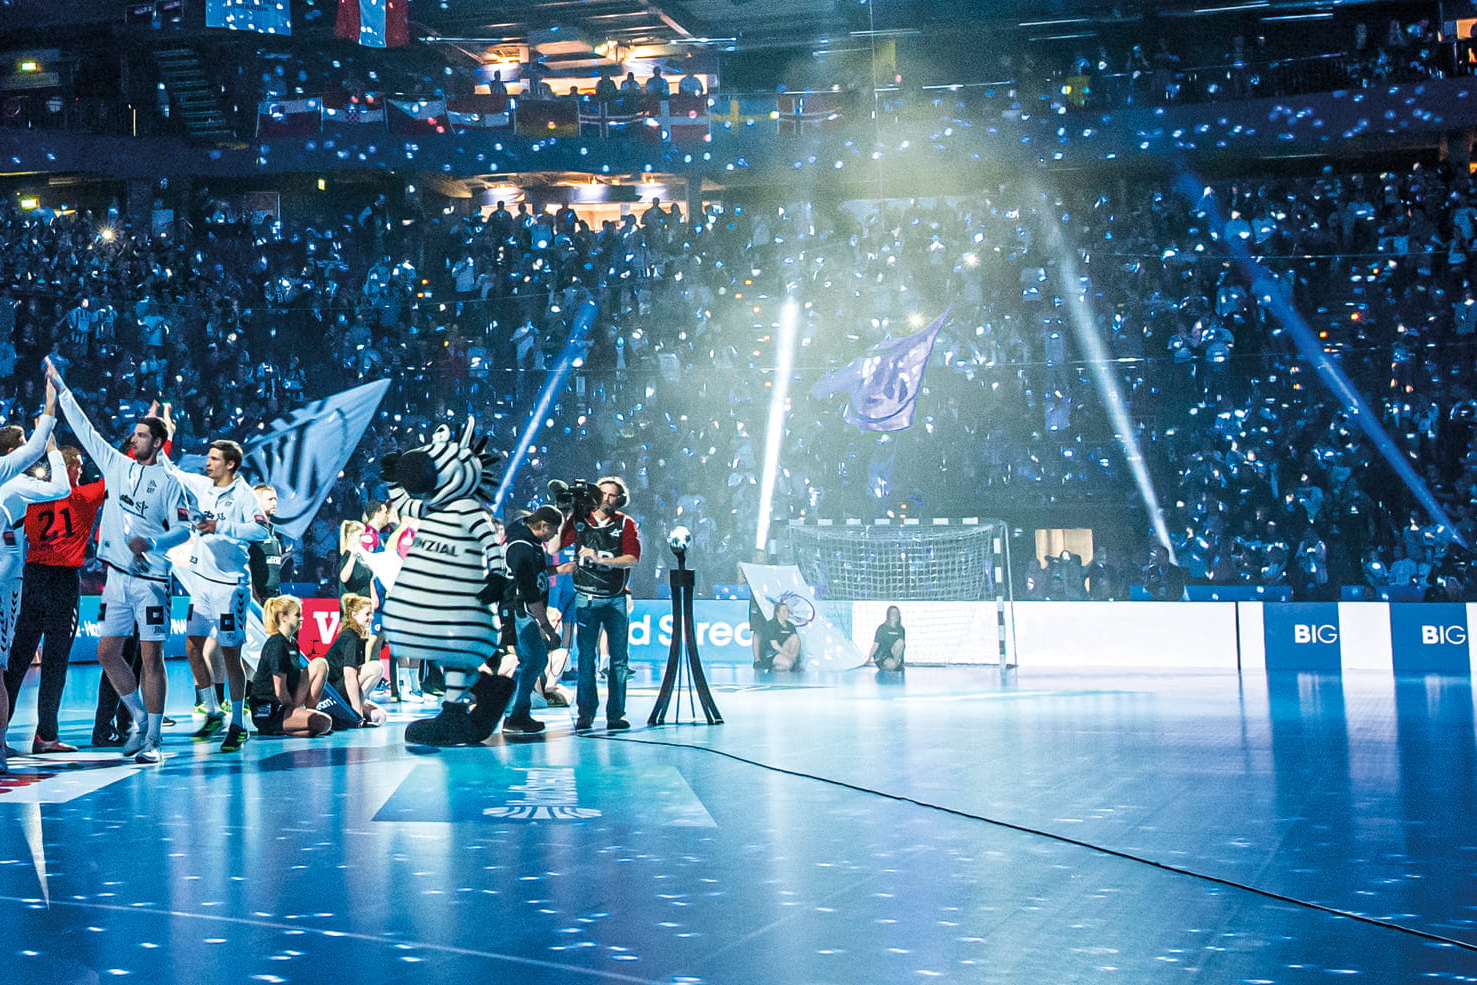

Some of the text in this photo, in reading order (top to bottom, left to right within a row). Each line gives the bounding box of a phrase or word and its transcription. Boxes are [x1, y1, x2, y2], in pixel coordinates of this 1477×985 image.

[37, 506, 75, 542] 21
[189, 556, 198, 565] 23
[1294, 624, 1338, 644] BIG
[1422, 625, 1467, 645] BIG
